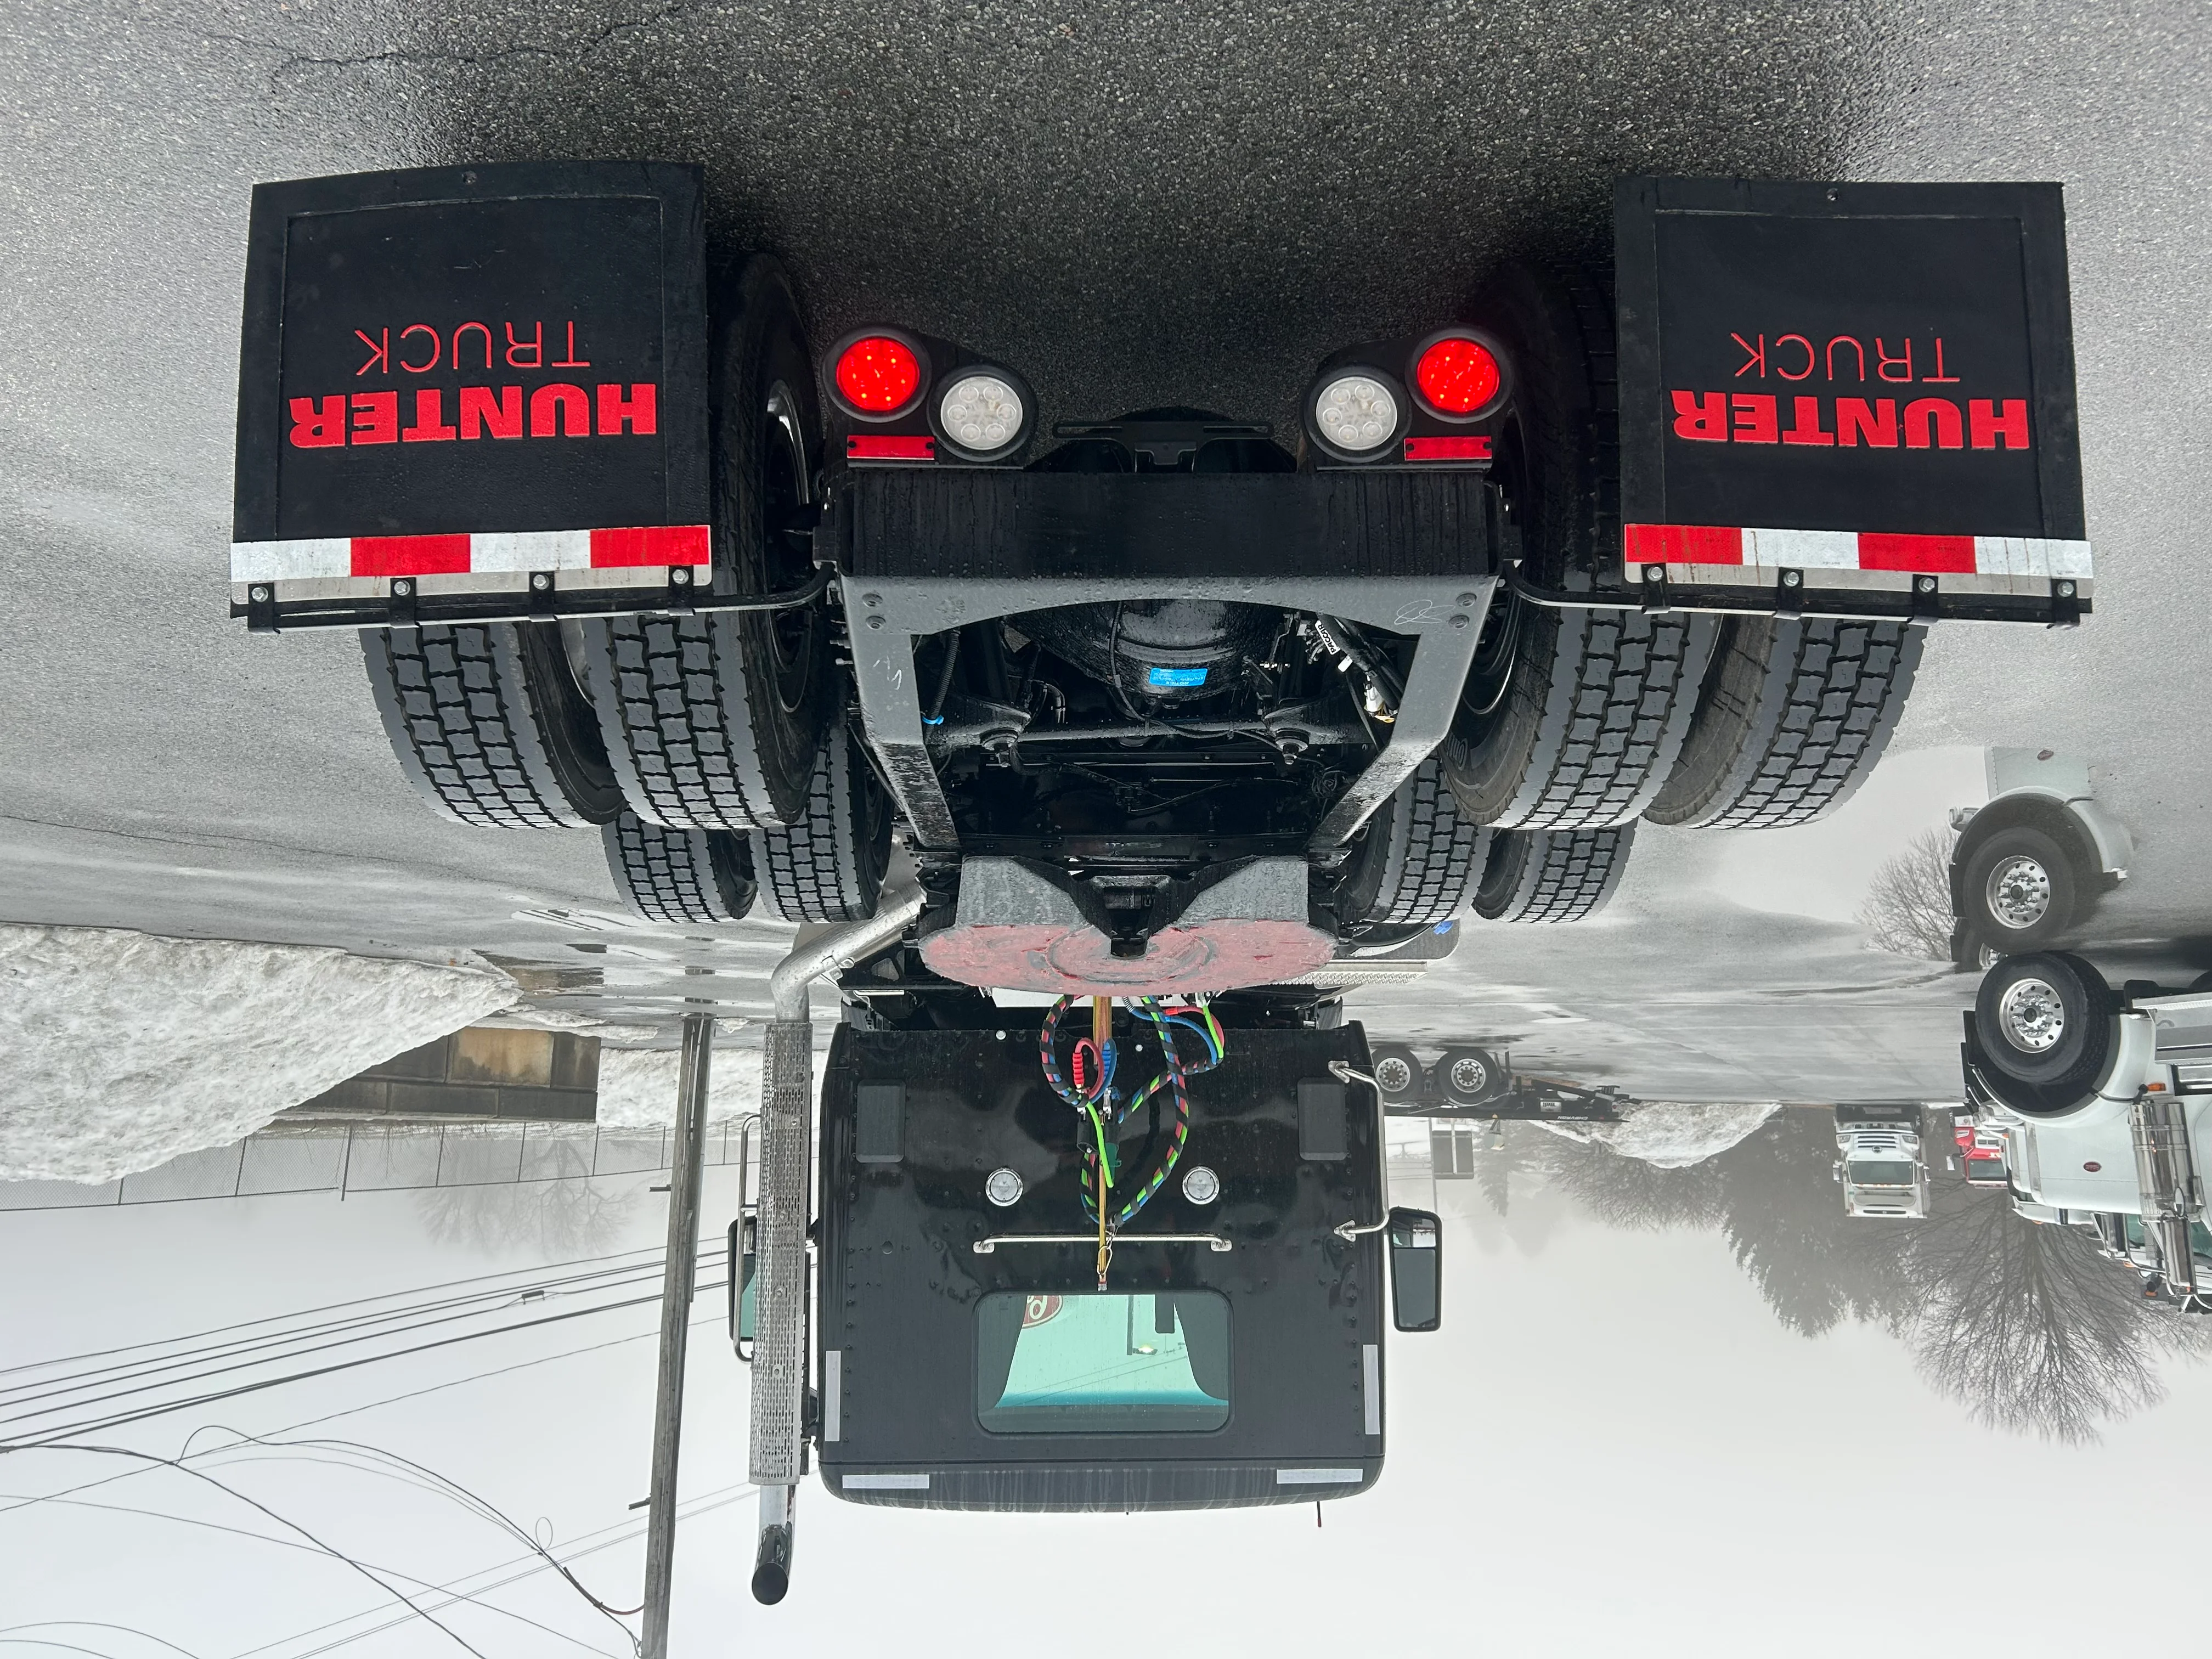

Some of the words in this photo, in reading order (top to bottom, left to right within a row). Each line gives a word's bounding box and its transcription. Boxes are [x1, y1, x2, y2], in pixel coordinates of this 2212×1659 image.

[356, 321, 590, 375] TRUCK
[1732, 333, 1960, 382] TRUCK
[289, 383, 656, 448] HUNTER
[1671, 391, 2029, 449] HUNTER
[1318, 624, 1336, 653] PACCAR
